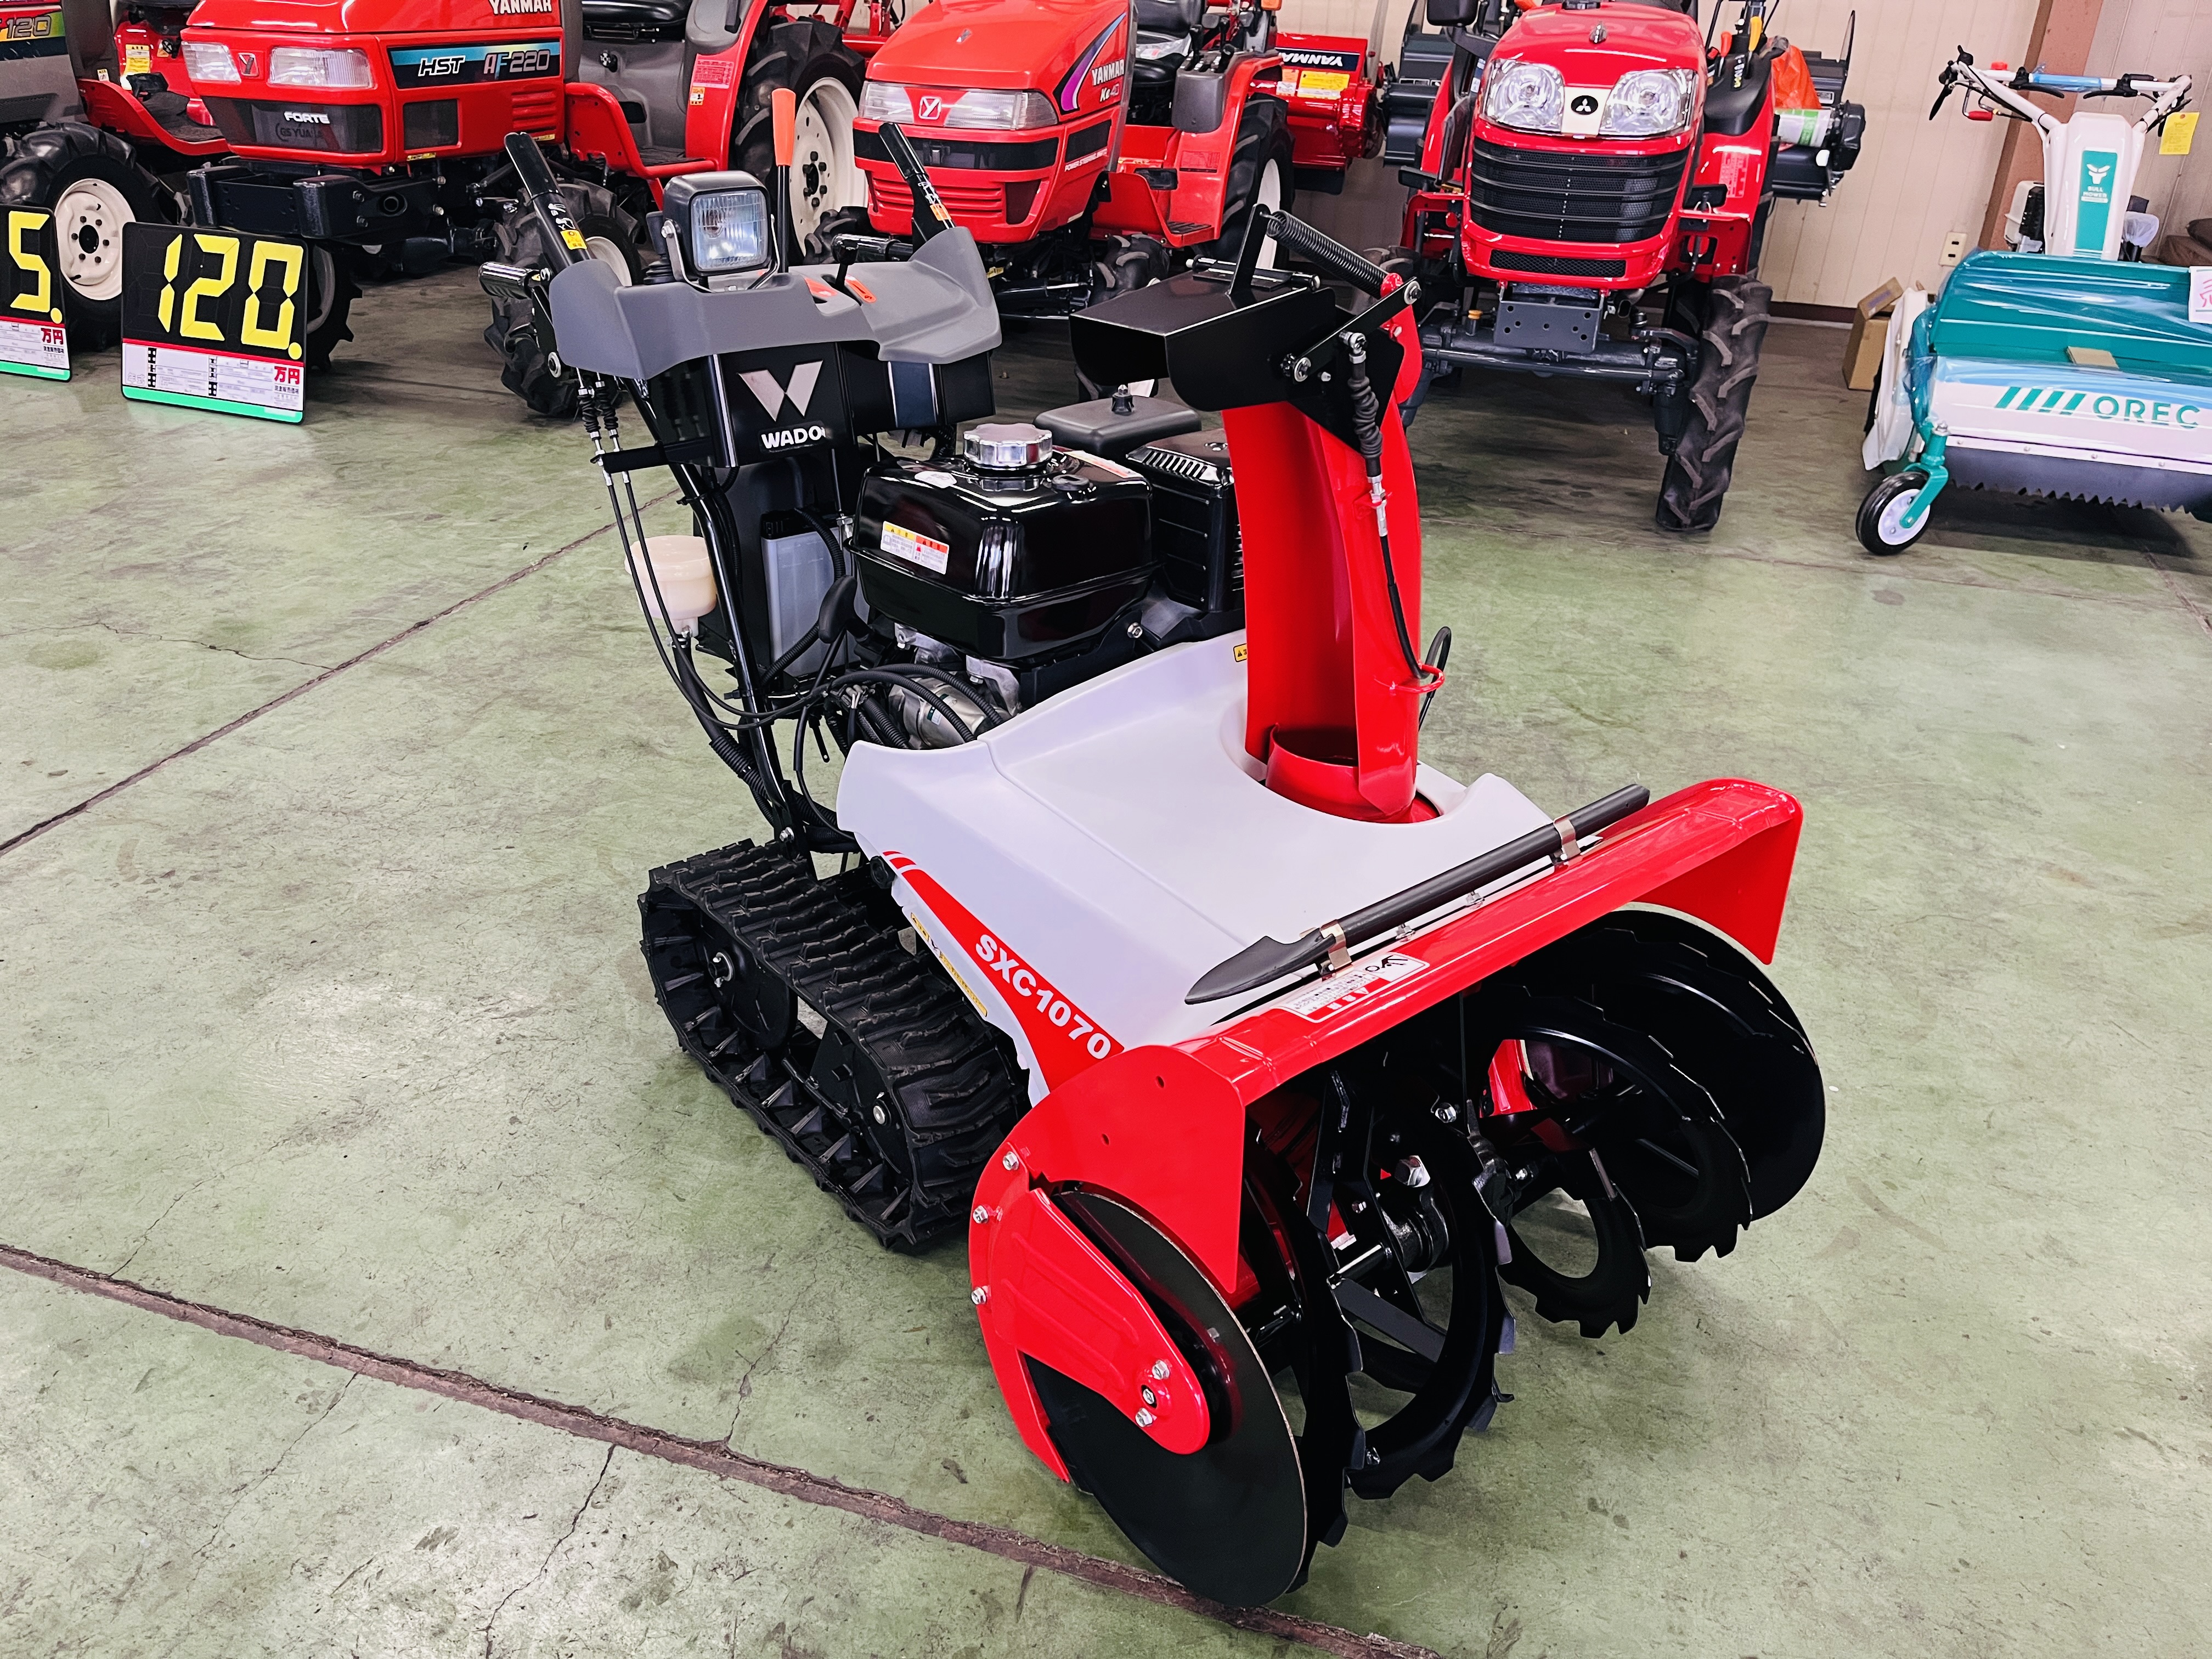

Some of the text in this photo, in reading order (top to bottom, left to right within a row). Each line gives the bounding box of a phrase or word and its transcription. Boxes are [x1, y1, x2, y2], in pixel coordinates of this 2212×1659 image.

[488, 0, 552, 14] YANMAR
[418, 55, 466, 77] HST
[1091, 59, 1125, 86] YANMAR
[284, 111, 330, 124] FORTE
[41, 328, 64, 345] 万円
[274, 366, 300, 385] 万円
[2093, 396, 2200, 429] OREC
[976, 934, 1111, 1059] SXC1070
